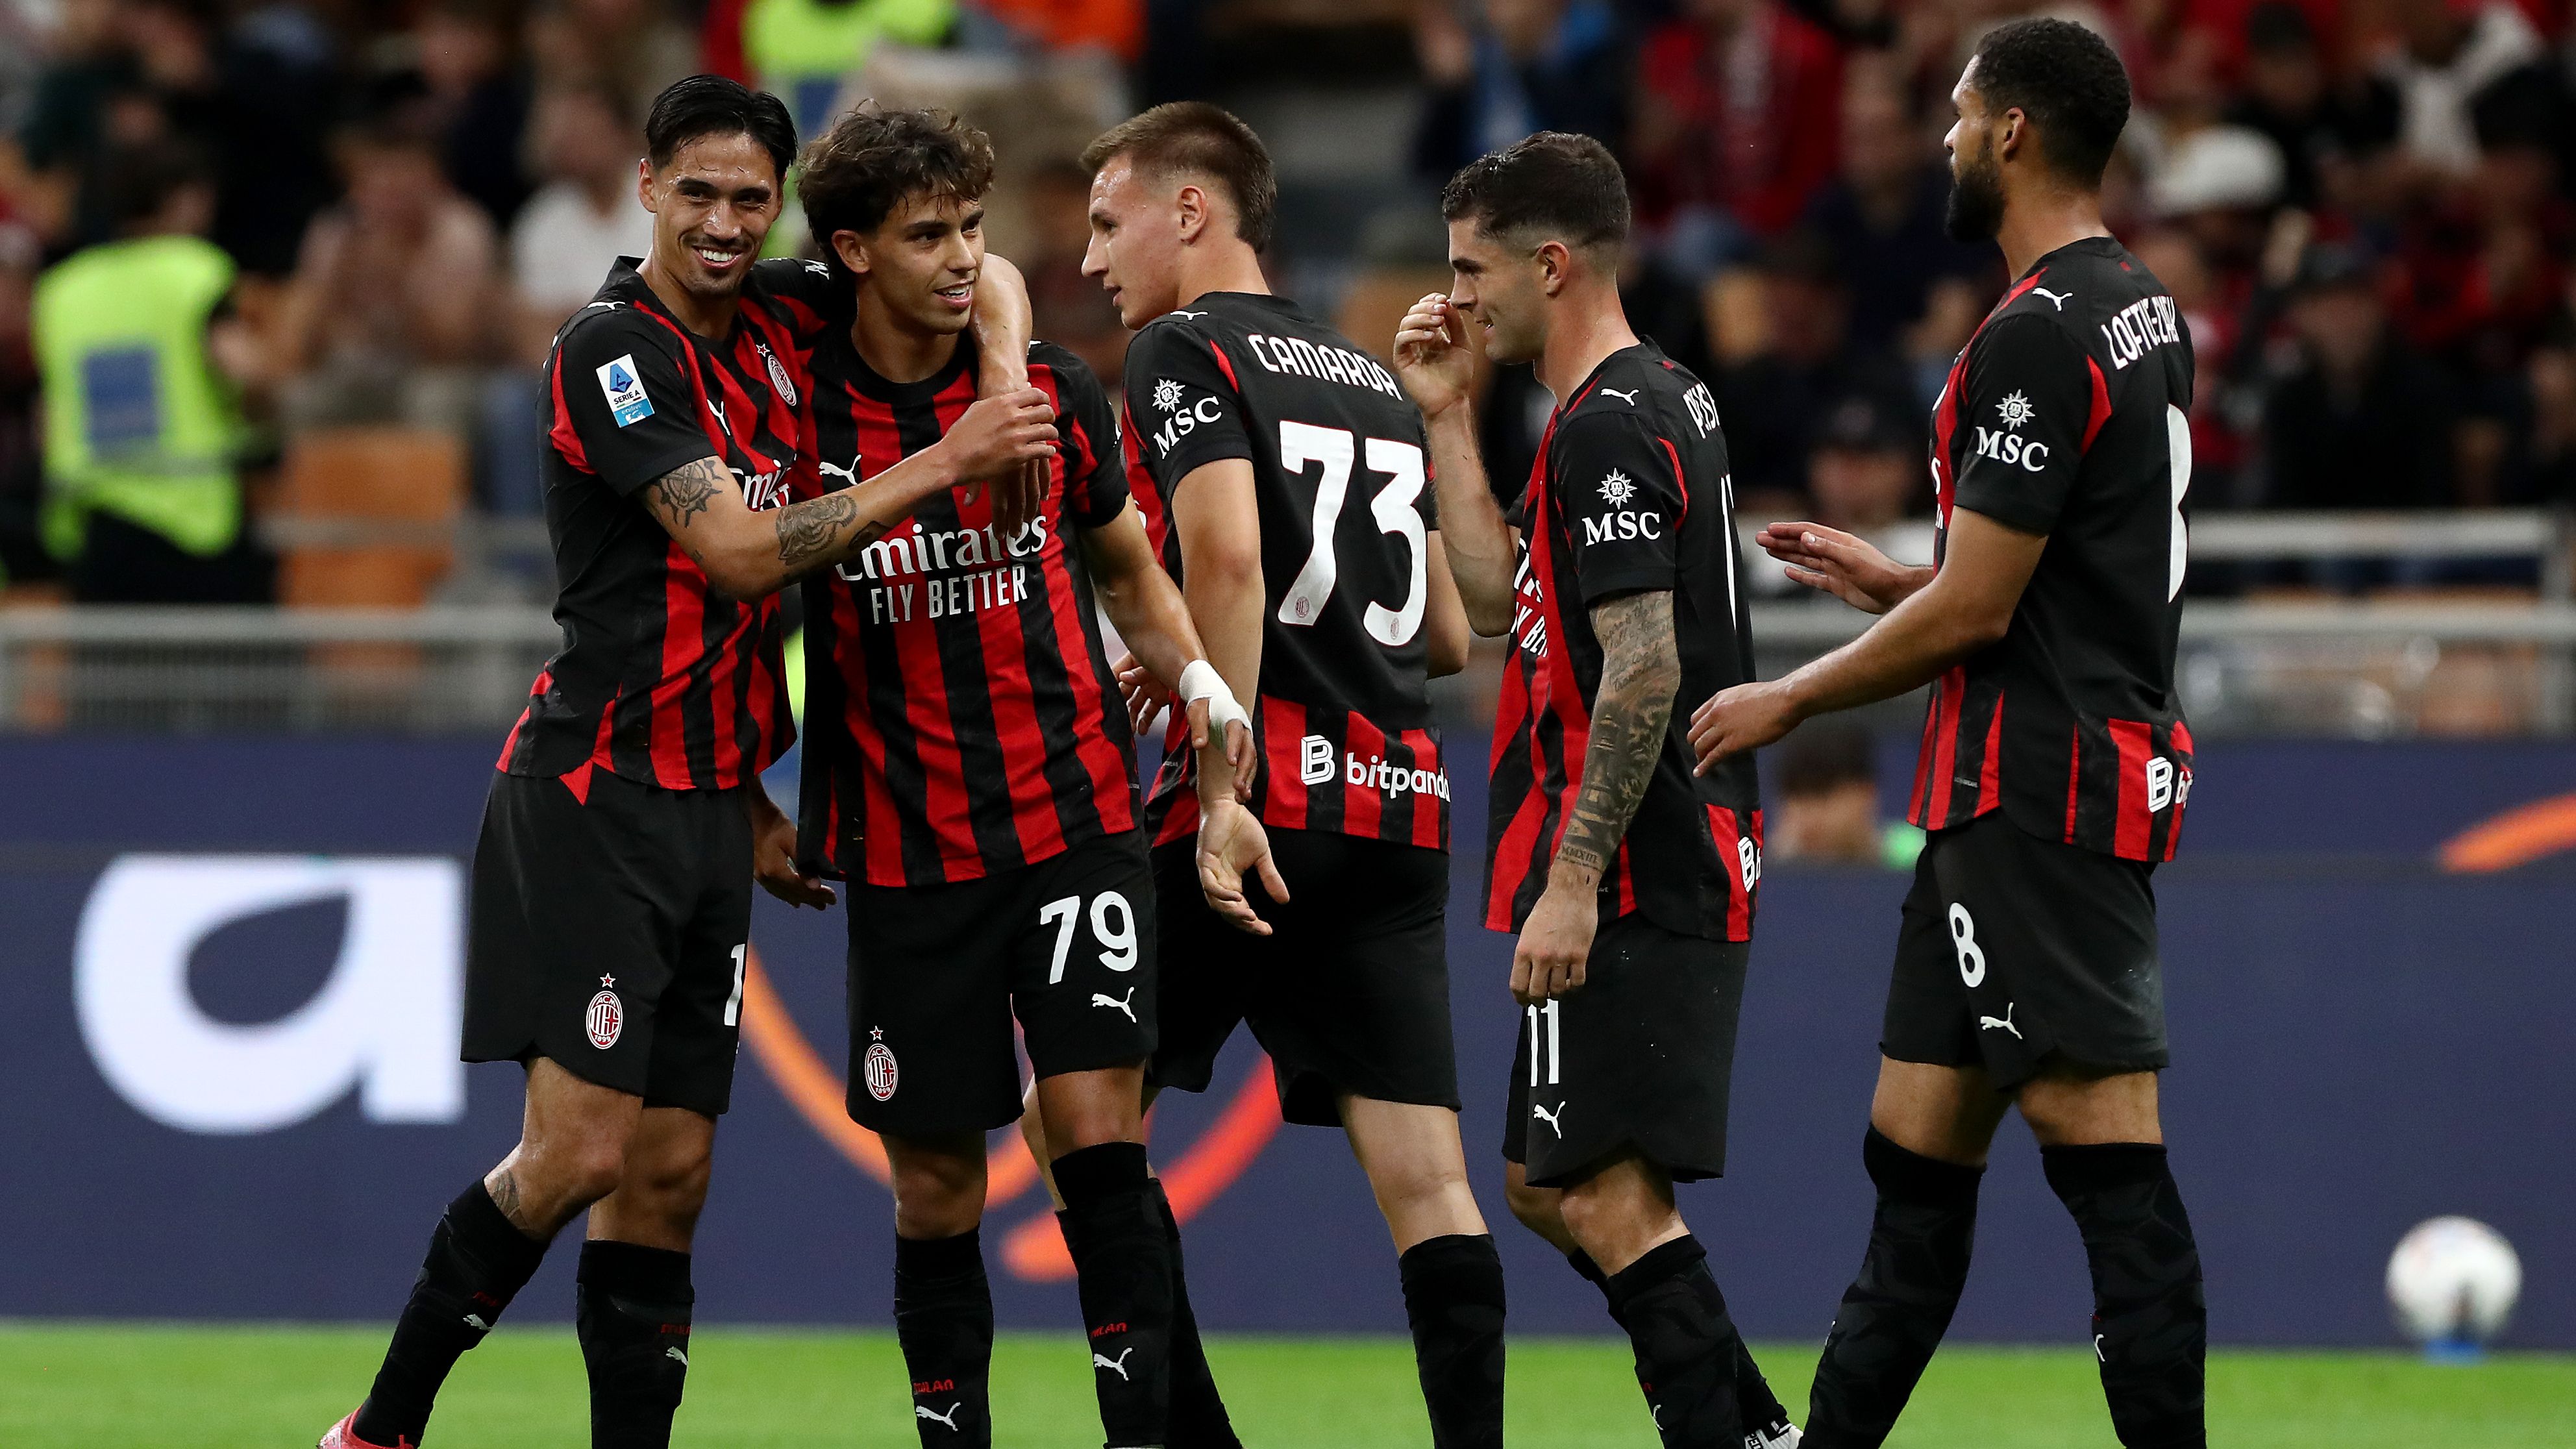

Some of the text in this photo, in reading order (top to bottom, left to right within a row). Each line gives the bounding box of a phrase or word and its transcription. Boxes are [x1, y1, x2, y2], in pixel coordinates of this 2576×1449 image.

[1248, 332, 1404, 401] CAMARDA
[613, 391, 634, 404] SERIE
[1153, 395, 1222, 460] MSC
[1975, 426, 2050, 472] MSC
[1278, 420, 1427, 647] 73
[1581, 510, 1661, 546] MSC
[871, 564, 1028, 625] FLY BETTER
[1346, 752, 1451, 802] bitpanda
[1040, 891, 1137, 985] 79
[1949, 902, 1986, 988] 8
[595, 995, 616, 1008] ACM
[593, 1034, 612, 1043] 1899
[871, 1048, 889, 1059] ACM
[1527, 997, 1559, 1087] 11
